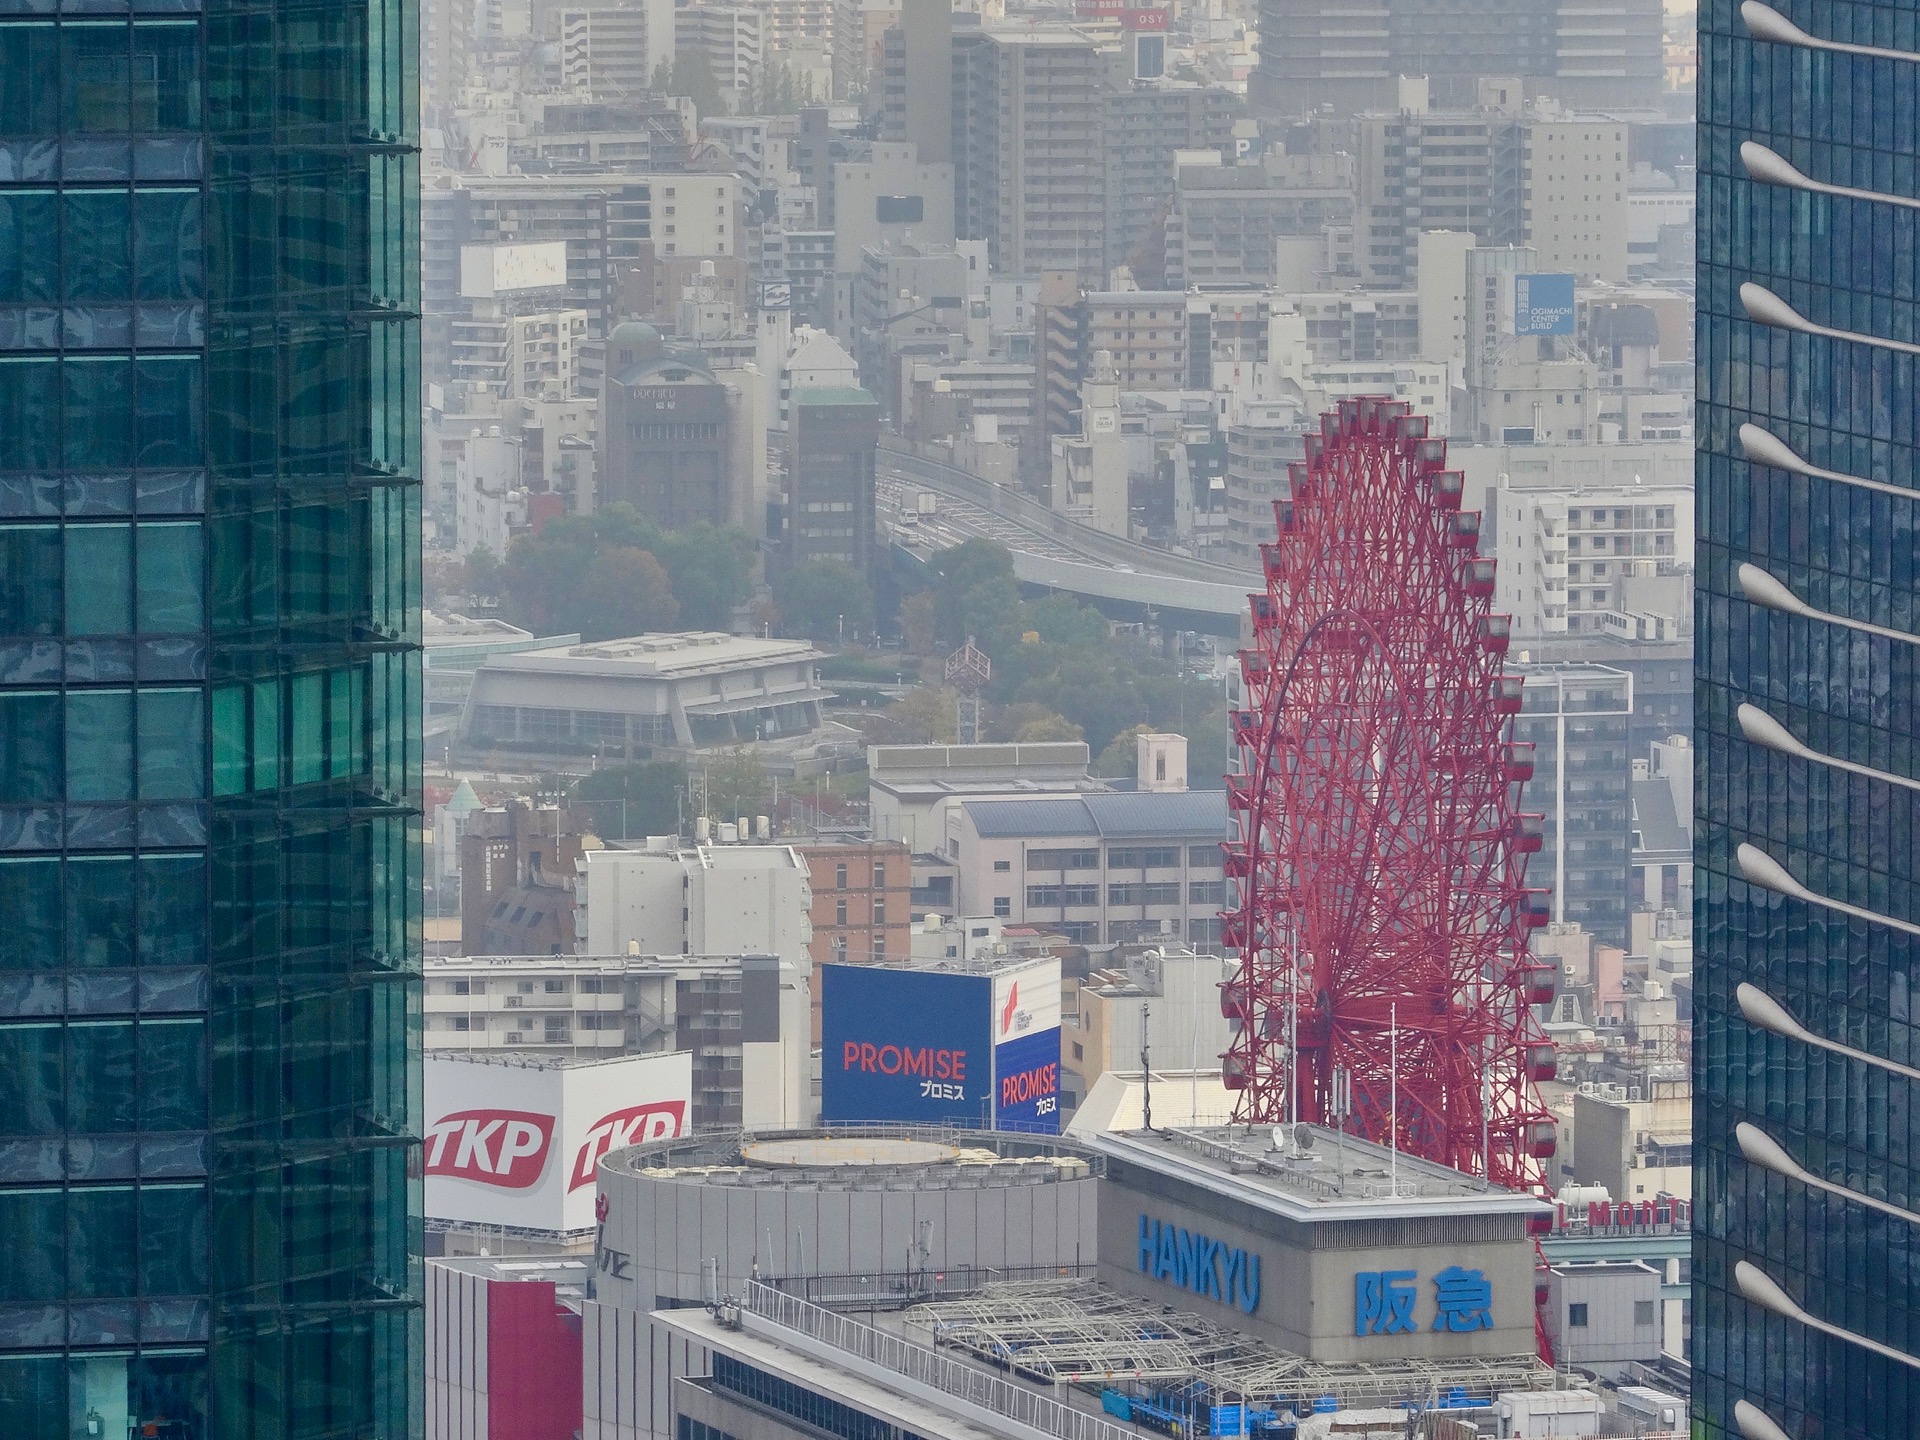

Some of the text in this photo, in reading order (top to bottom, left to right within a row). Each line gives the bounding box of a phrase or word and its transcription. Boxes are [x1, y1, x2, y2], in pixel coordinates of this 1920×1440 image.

[1139, 15, 1164, 24] OSY
[1235, 139, 1250, 158] P
[1485, 276, 1497, 350] 関西医科専門
[1530, 307, 1573, 316] OGIMACHI
[1530, 315, 1560, 323] CENTER
[1530, 322, 1553, 330] BUILD
[843, 1041, 967, 1080] PROMISE
[920, 1080, 965, 1100] プロミス
[1002, 1063, 1057, 1108] PROMISE
[1036, 1096, 1057, 1116] プロミス
[427, 1119, 544, 1175] TKP
[1588, 1199, 1692, 1228] MONT
[1138, 1213, 1261, 1314] HANKYU
[1355, 1265, 1494, 1337] 阪急
